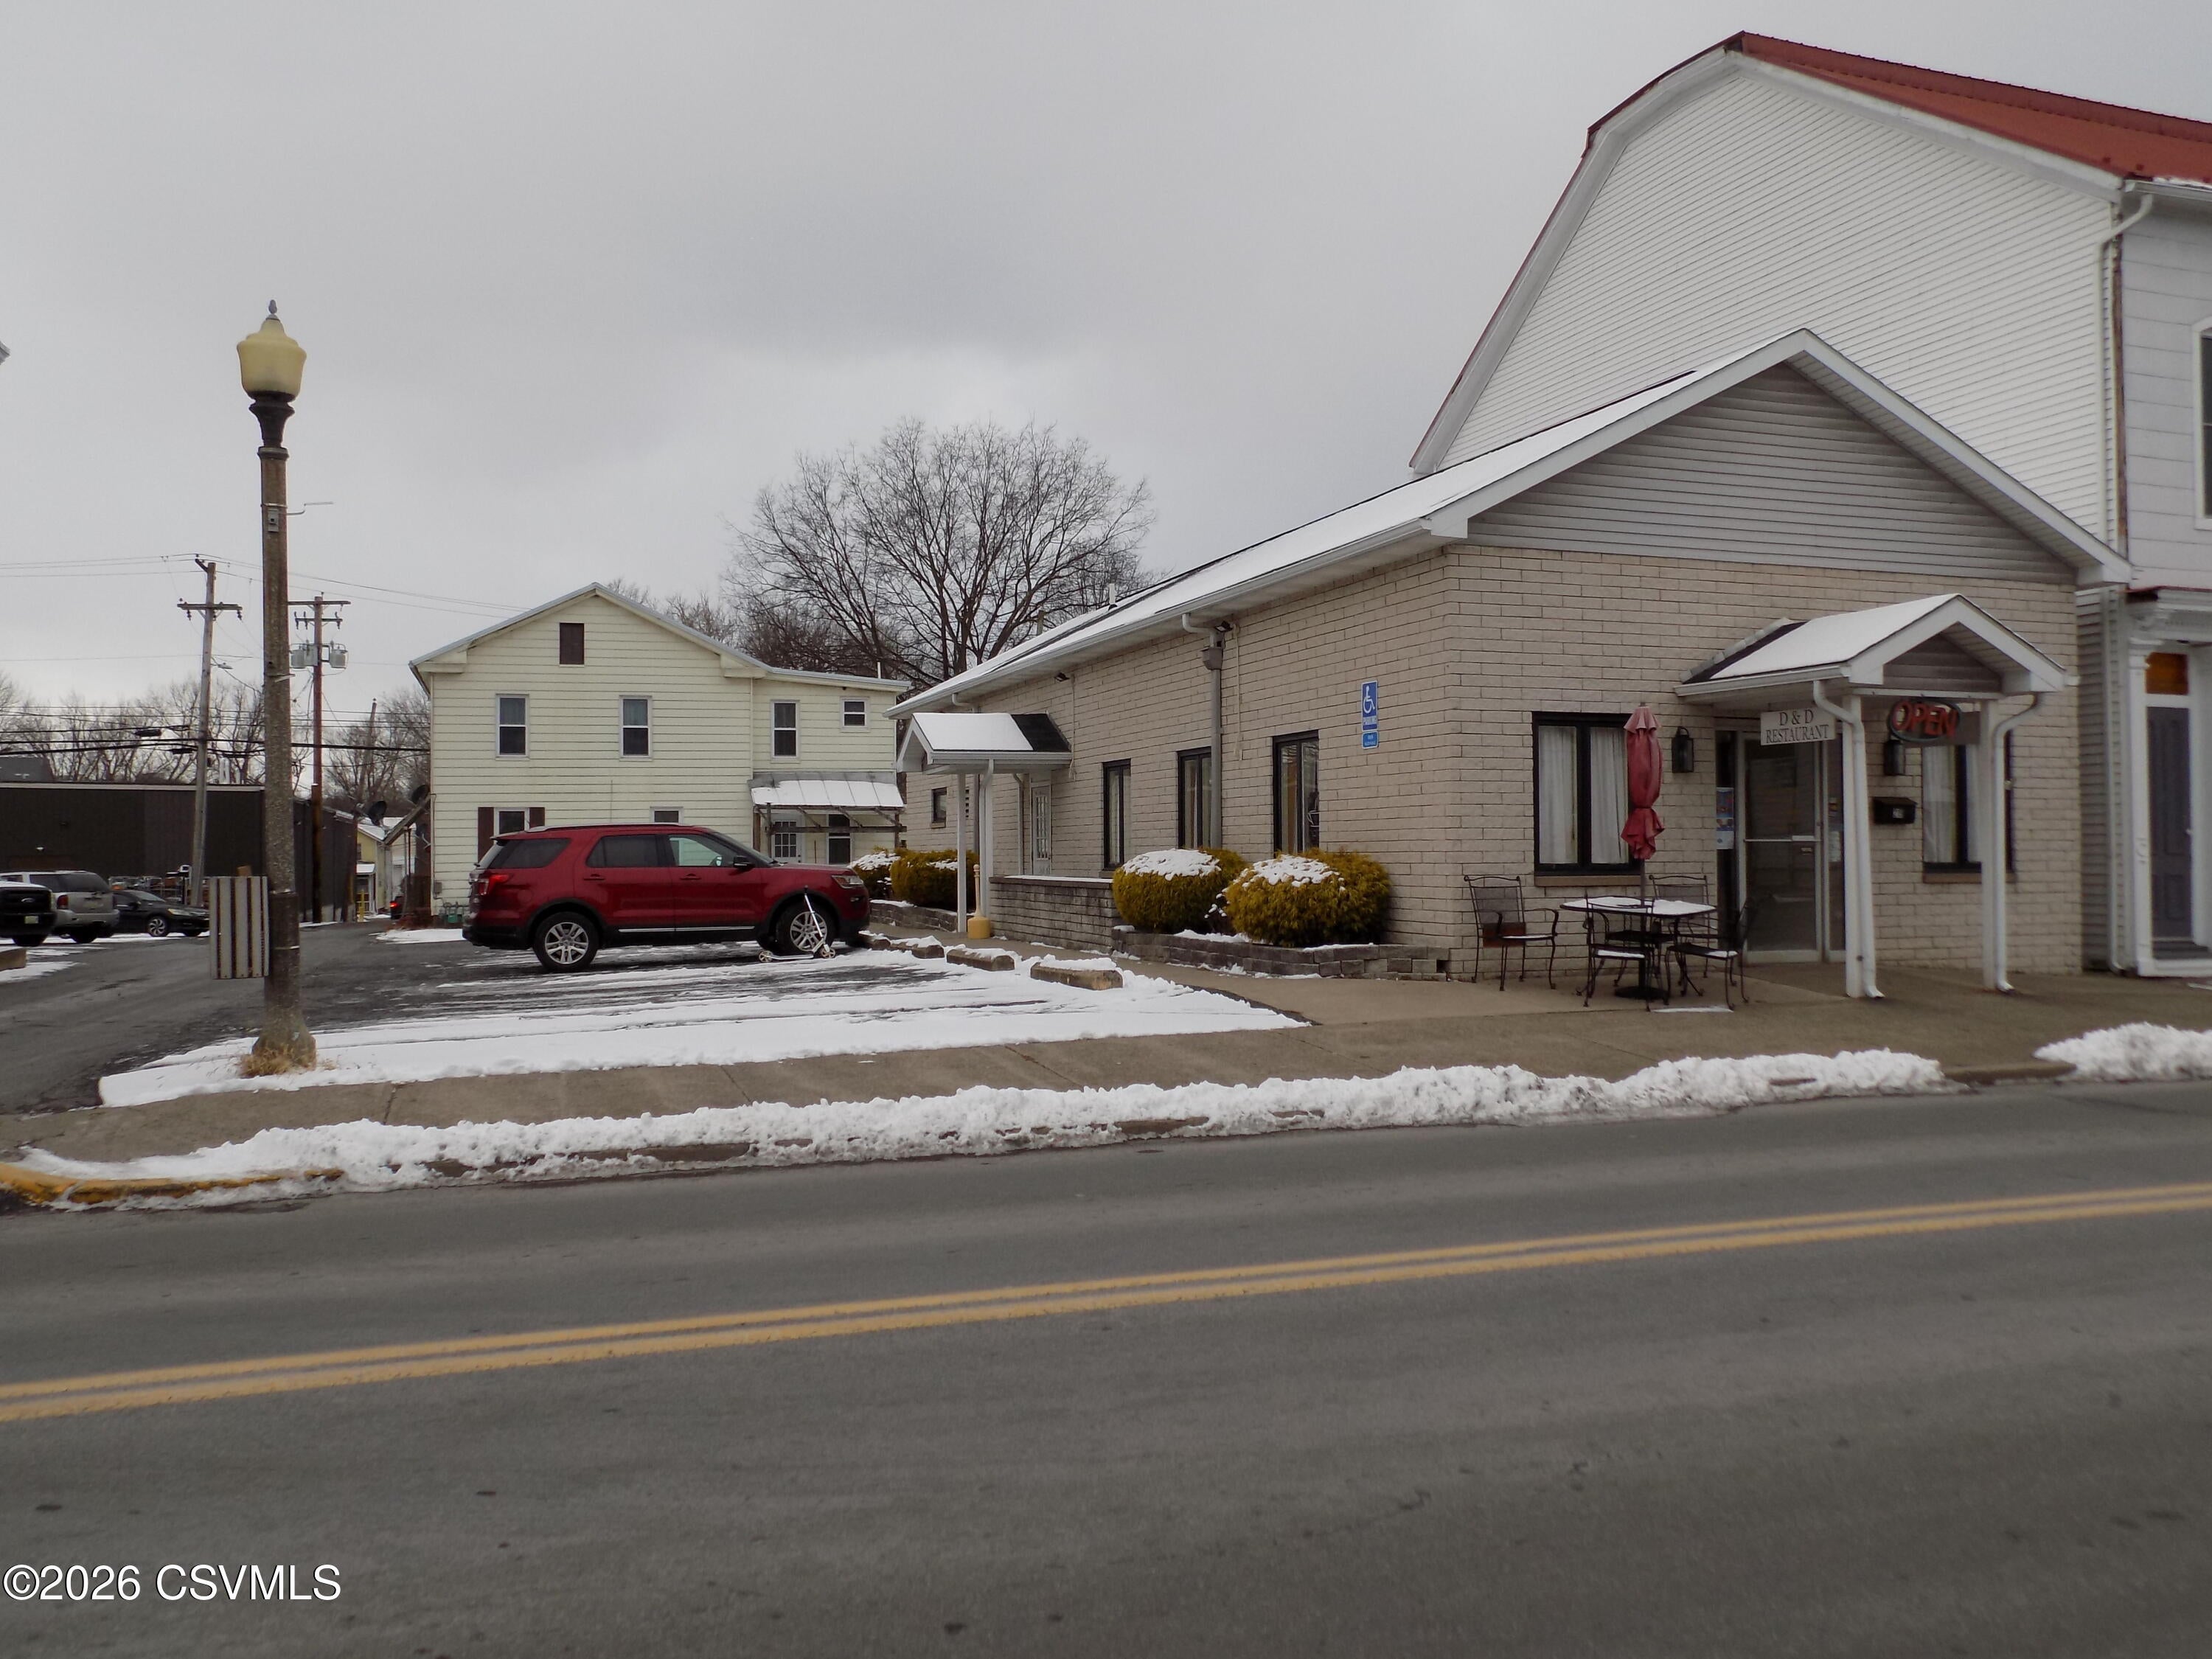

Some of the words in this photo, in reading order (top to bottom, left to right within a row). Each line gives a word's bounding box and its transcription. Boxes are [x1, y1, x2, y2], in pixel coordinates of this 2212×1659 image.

[1778, 712, 1789, 726] D
[1792, 710, 1801, 725] &
[1804, 709, 1814, 723] D
[1891, 700, 1958, 737] OPEN
[1765, 724, 1829, 744] RESTAURANT
